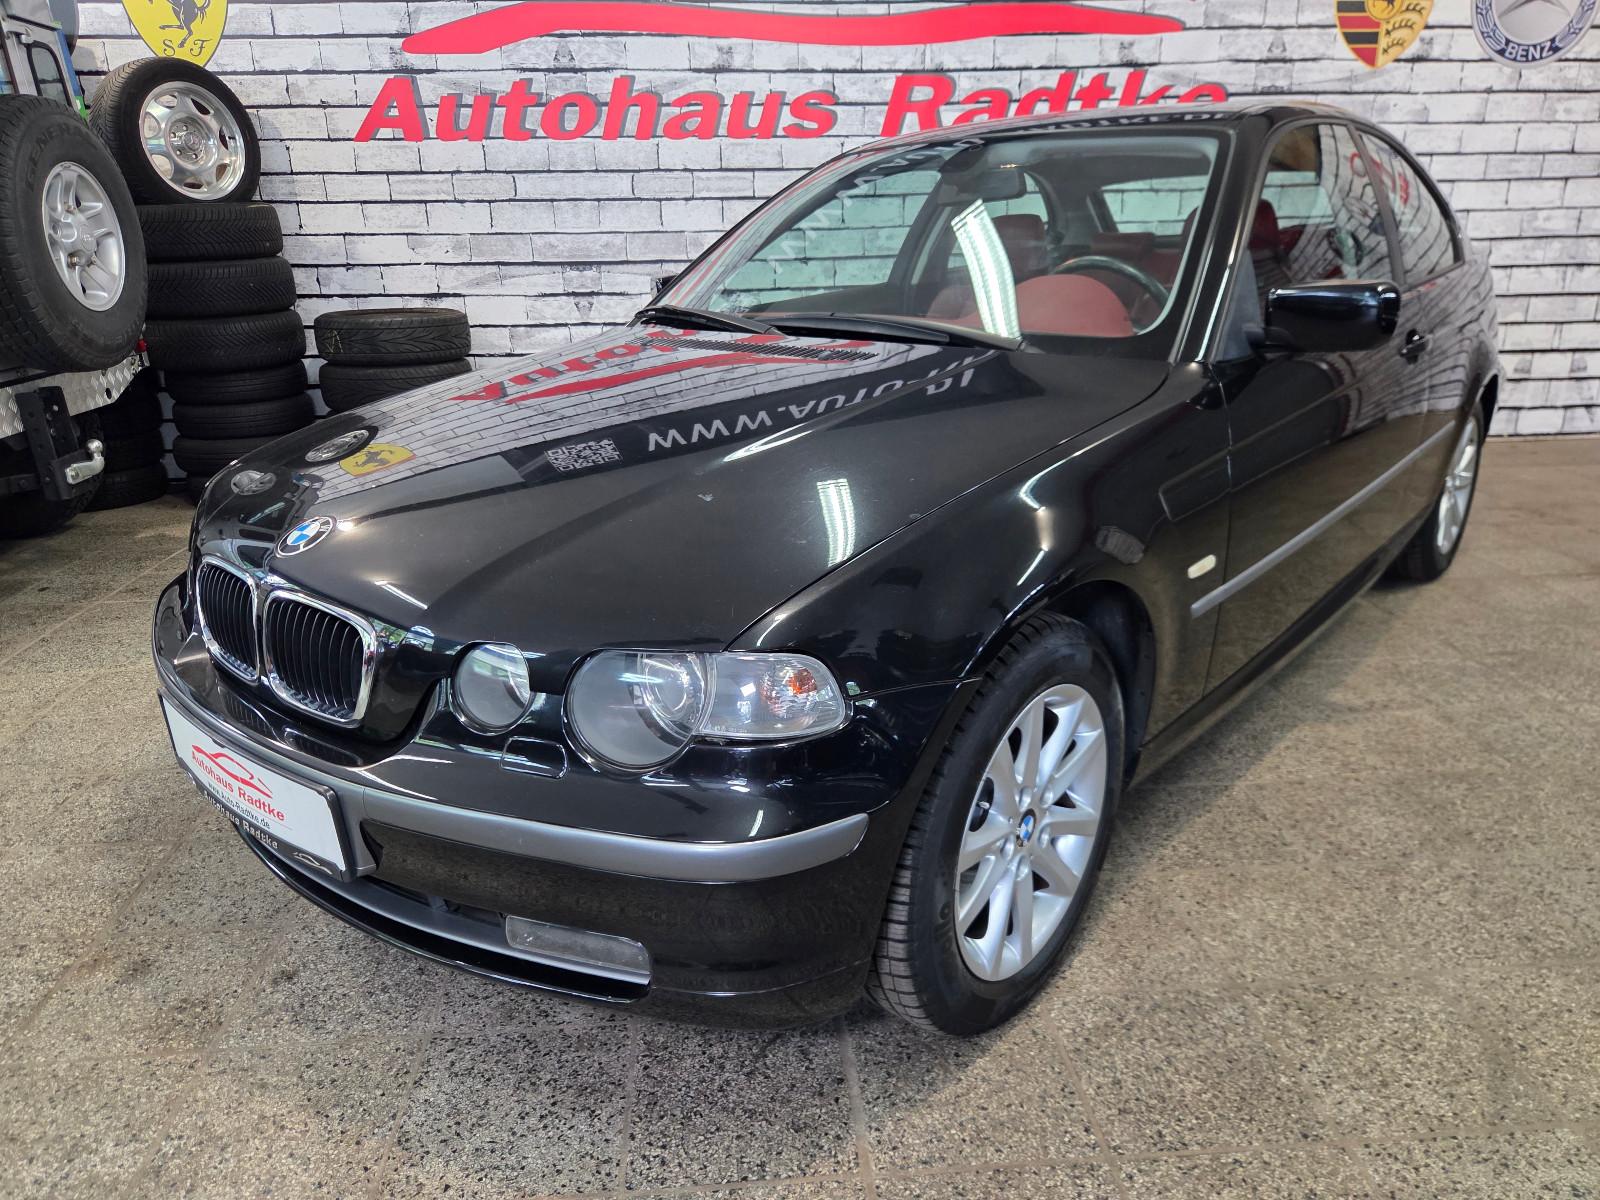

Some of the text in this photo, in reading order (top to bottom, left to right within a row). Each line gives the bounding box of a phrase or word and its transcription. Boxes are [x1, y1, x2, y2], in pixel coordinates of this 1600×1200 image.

[1505, 41, 1552, 61] BENZ
[353, 75, 840, 143] Autohaus
[191, 750, 285, 821] Autohaus Radtke
[203, 789, 278, 850] Autohaus Radtke
